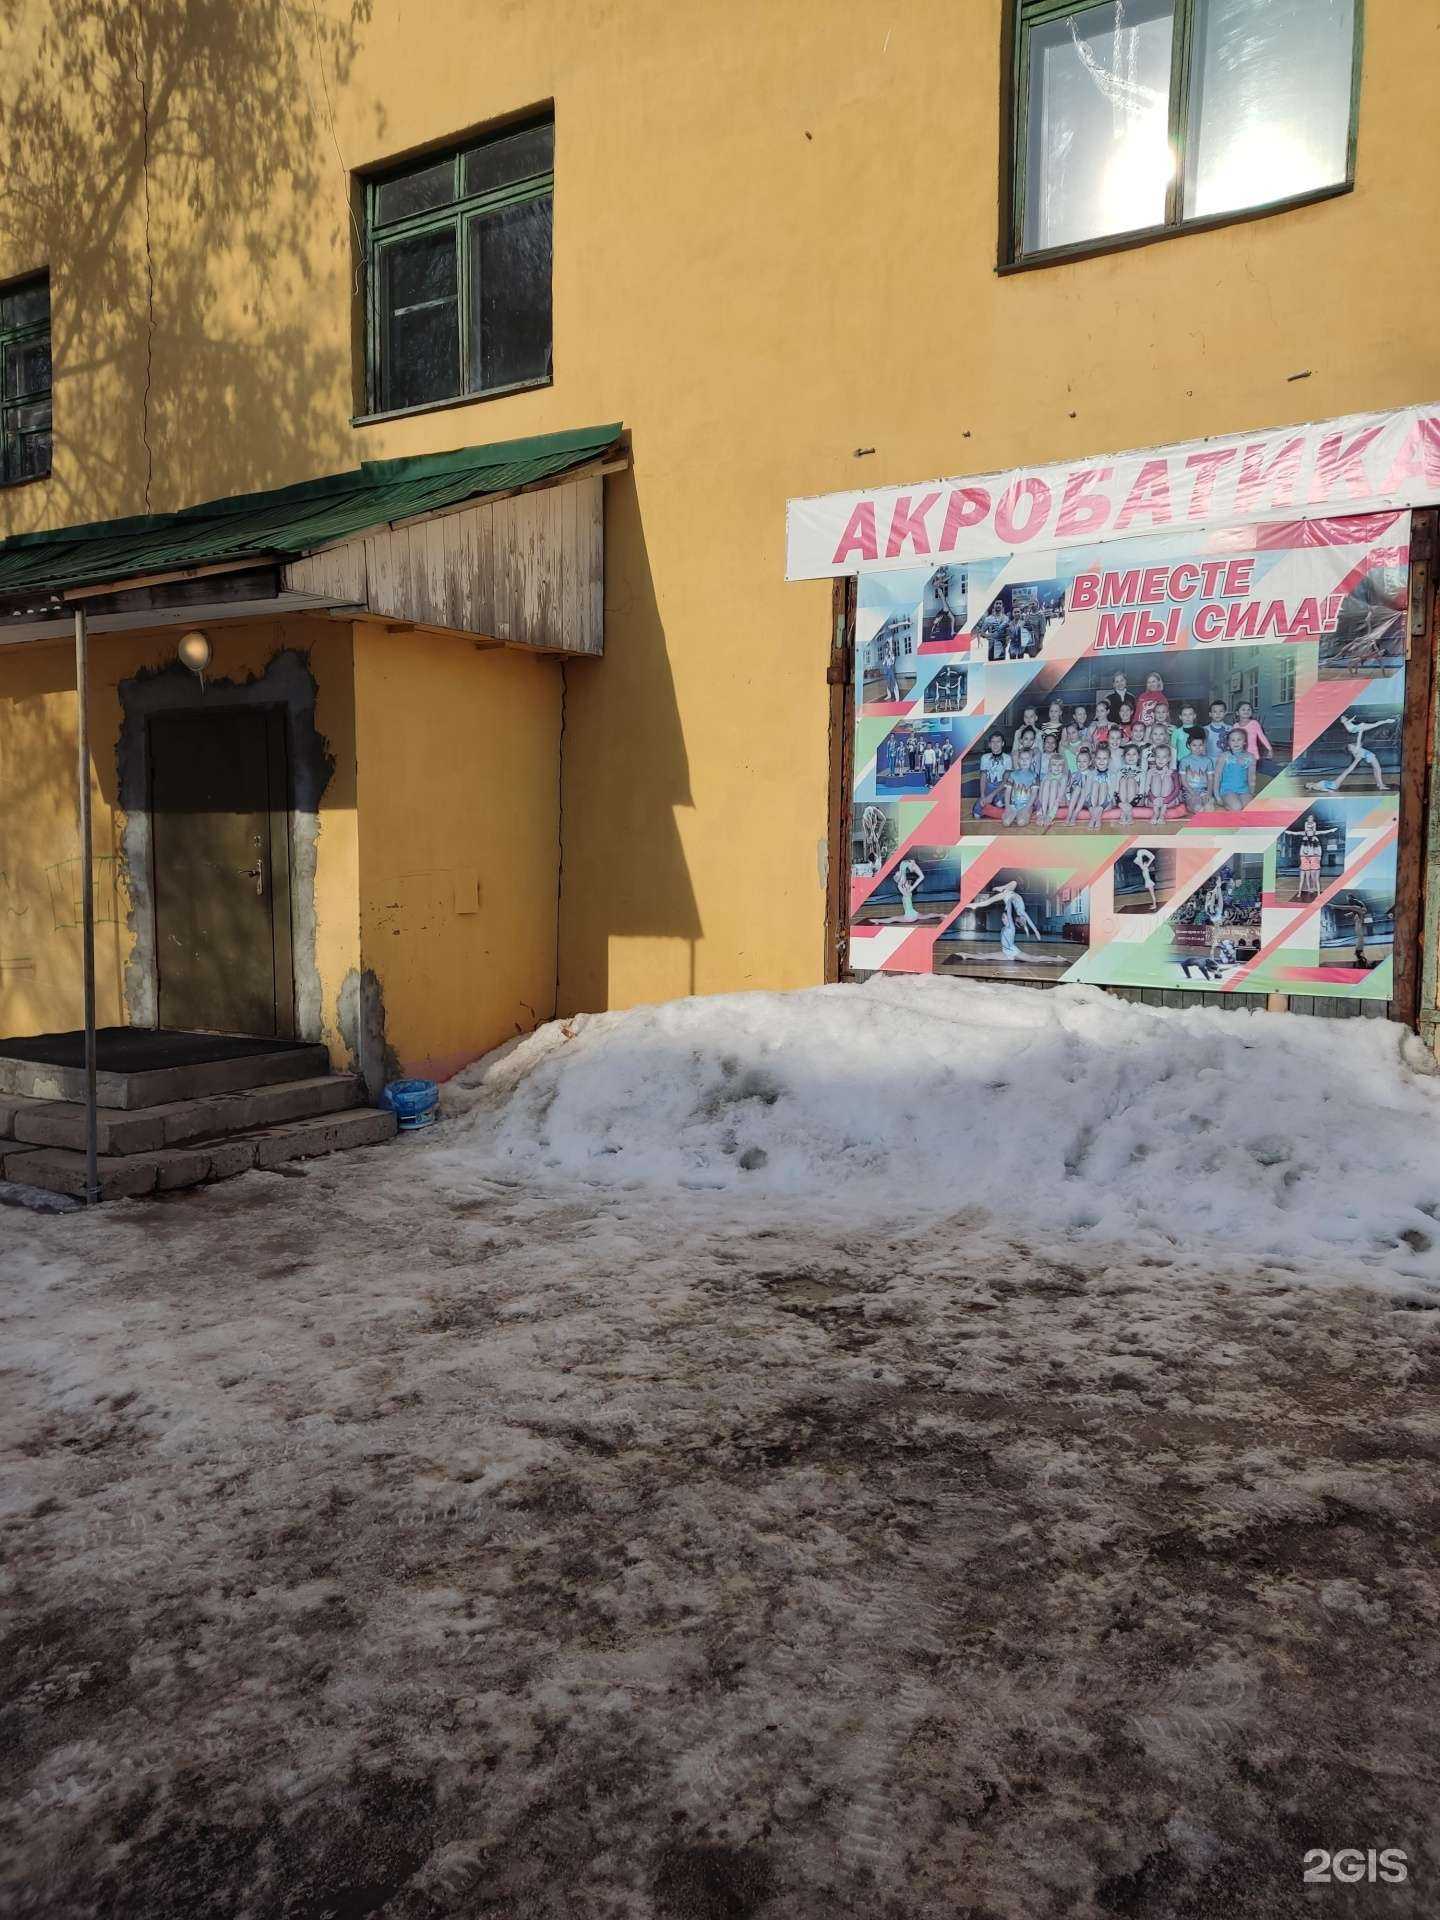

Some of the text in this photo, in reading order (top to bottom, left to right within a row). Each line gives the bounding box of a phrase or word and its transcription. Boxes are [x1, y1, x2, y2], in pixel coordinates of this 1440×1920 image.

[832, 417, 1440, 564] АКРОБАТИКА
[1068, 558, 1255, 612] ВМЕСТЕ
[1093, 593, 1344, 650] МЫ СИЛА!
